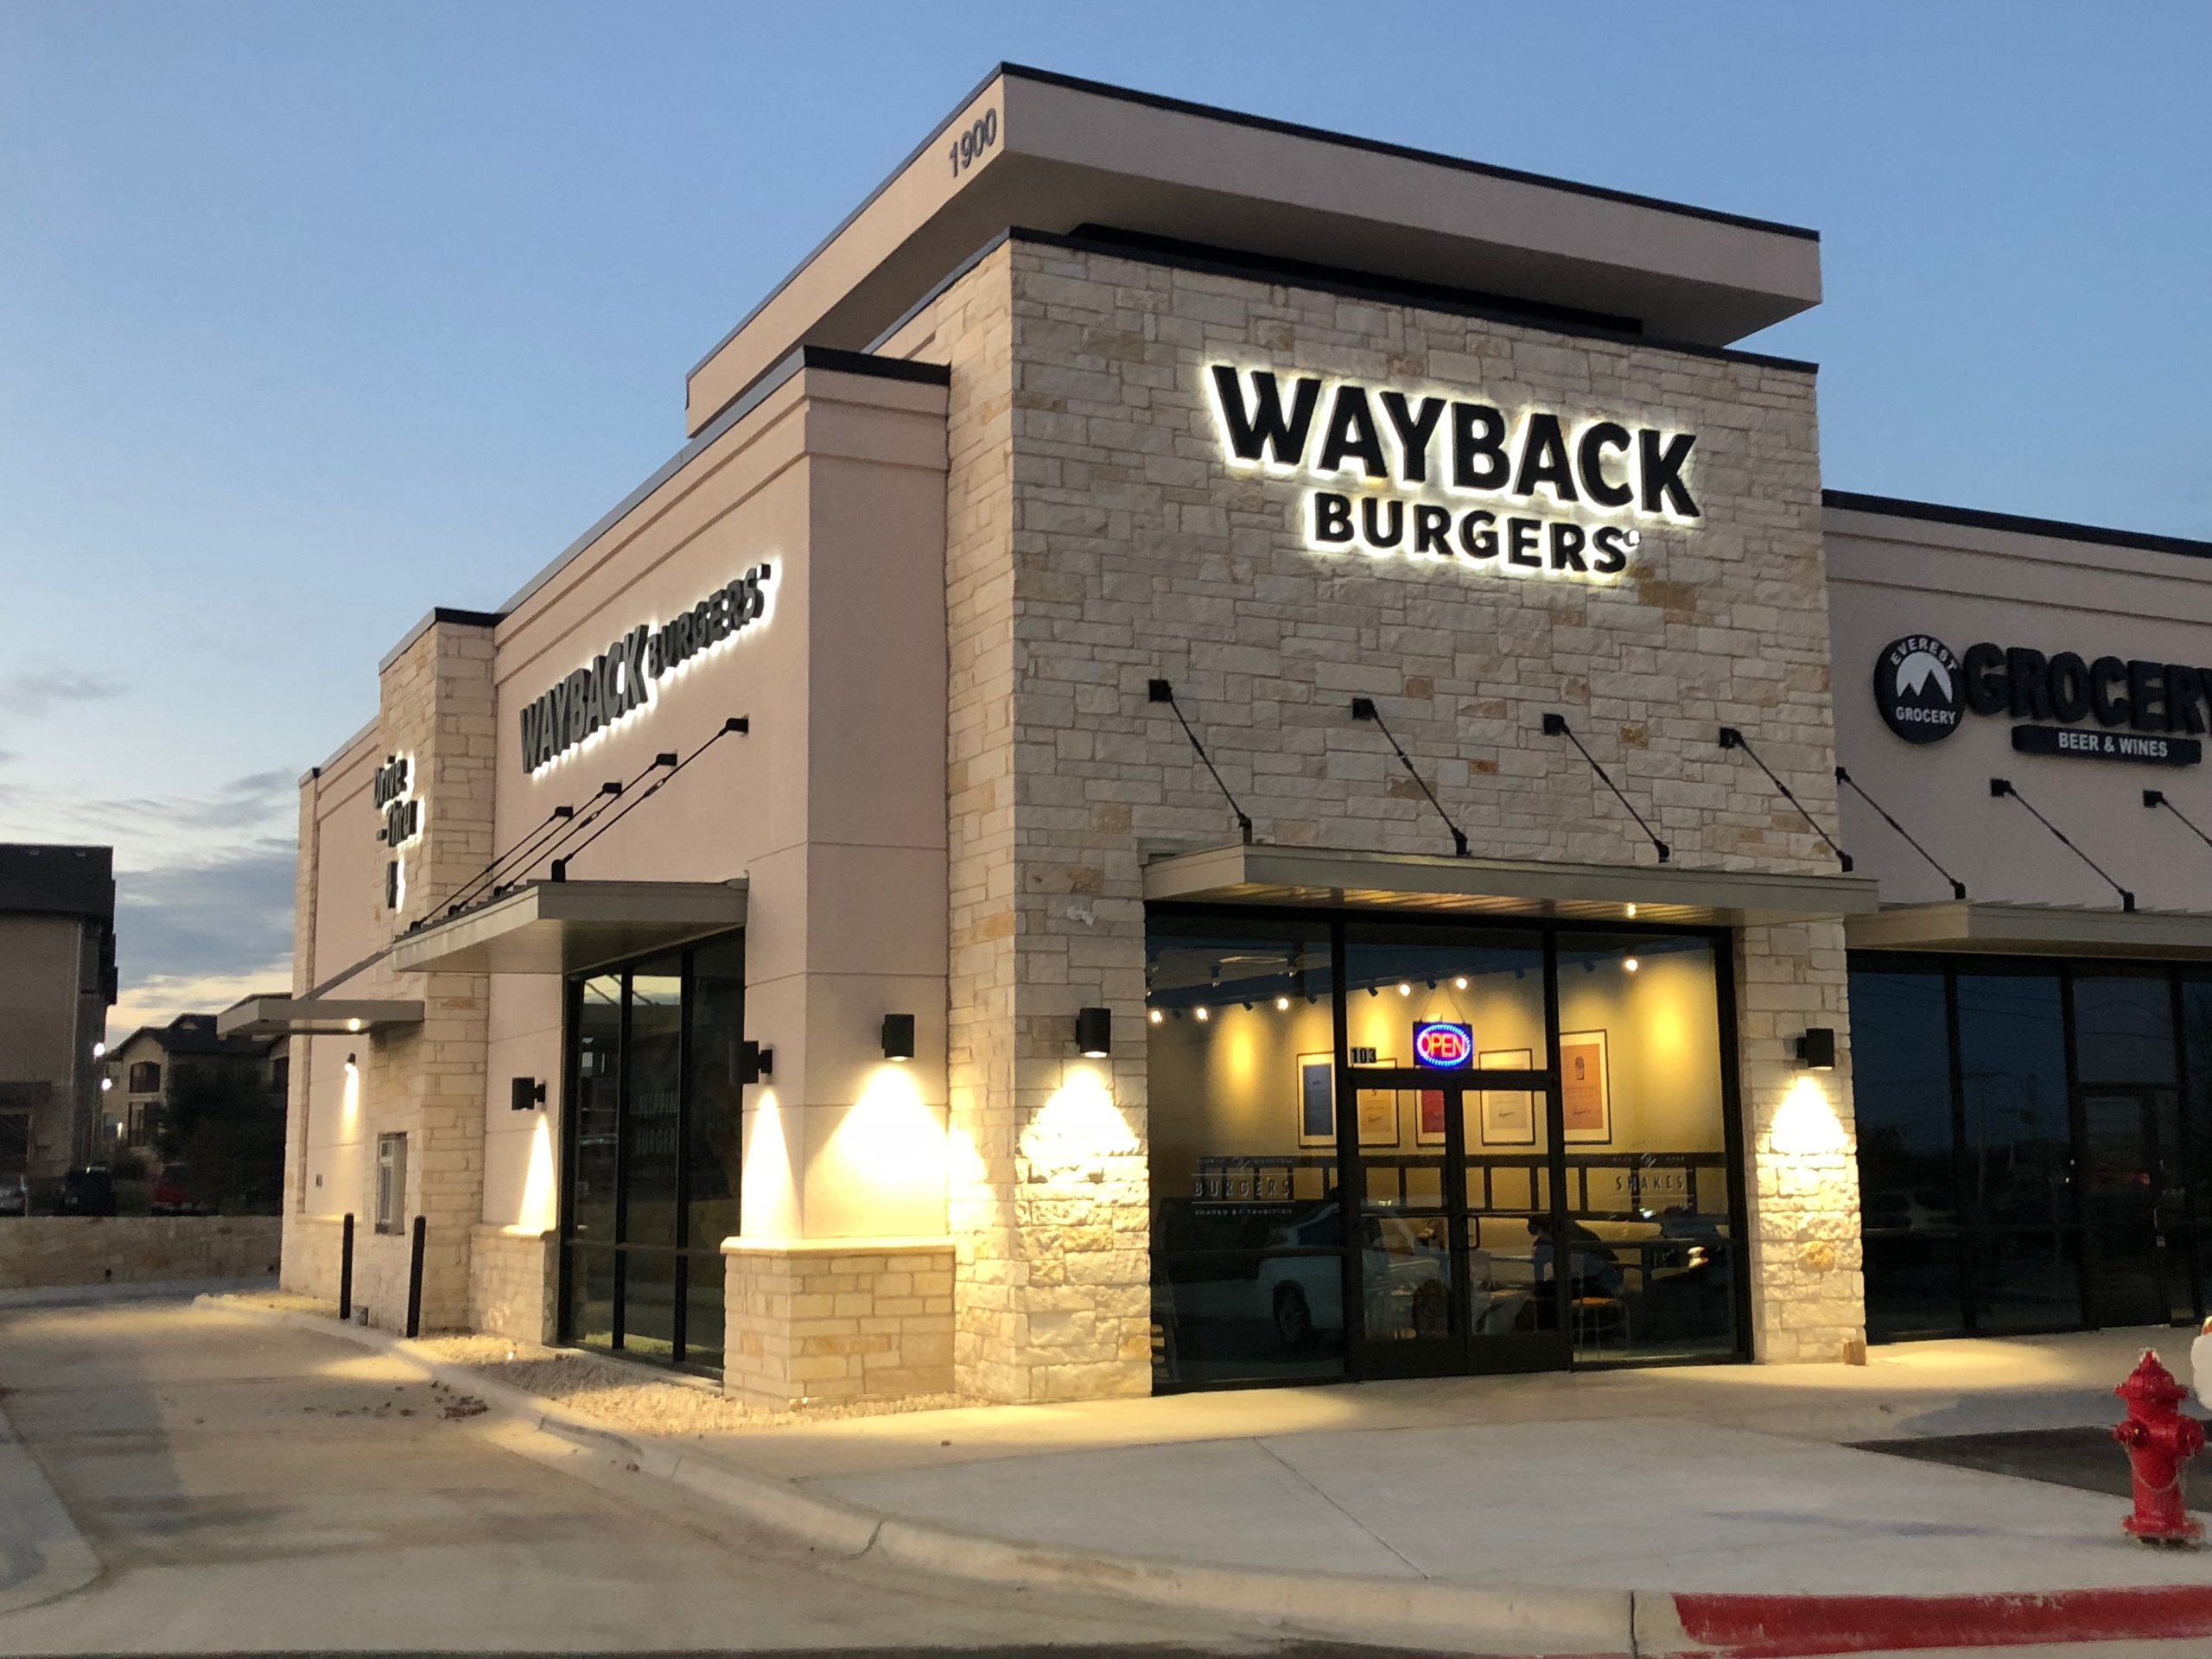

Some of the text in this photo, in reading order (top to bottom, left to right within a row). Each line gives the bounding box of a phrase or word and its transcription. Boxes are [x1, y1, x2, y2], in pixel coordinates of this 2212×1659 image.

[949, 107, 998, 178] 1900
[1211, 365, 1700, 518] WAYBACK
[1314, 492, 1628, 574] BURGERS
[1890, 638, 1958, 671] EVEREST
[519, 567, 766, 774] WAYBACK BURGERS
[1895, 706, 1956, 725] GROCERY
[2058, 732, 2169, 758] BEER & WINES
[1351, 1047, 1376, 1064] 103
[1421, 1032, 1466, 1058] OPEN
[1193, 1179, 1292, 1198] BURGERS
[1616, 1174, 1684, 1192] SHAKES
